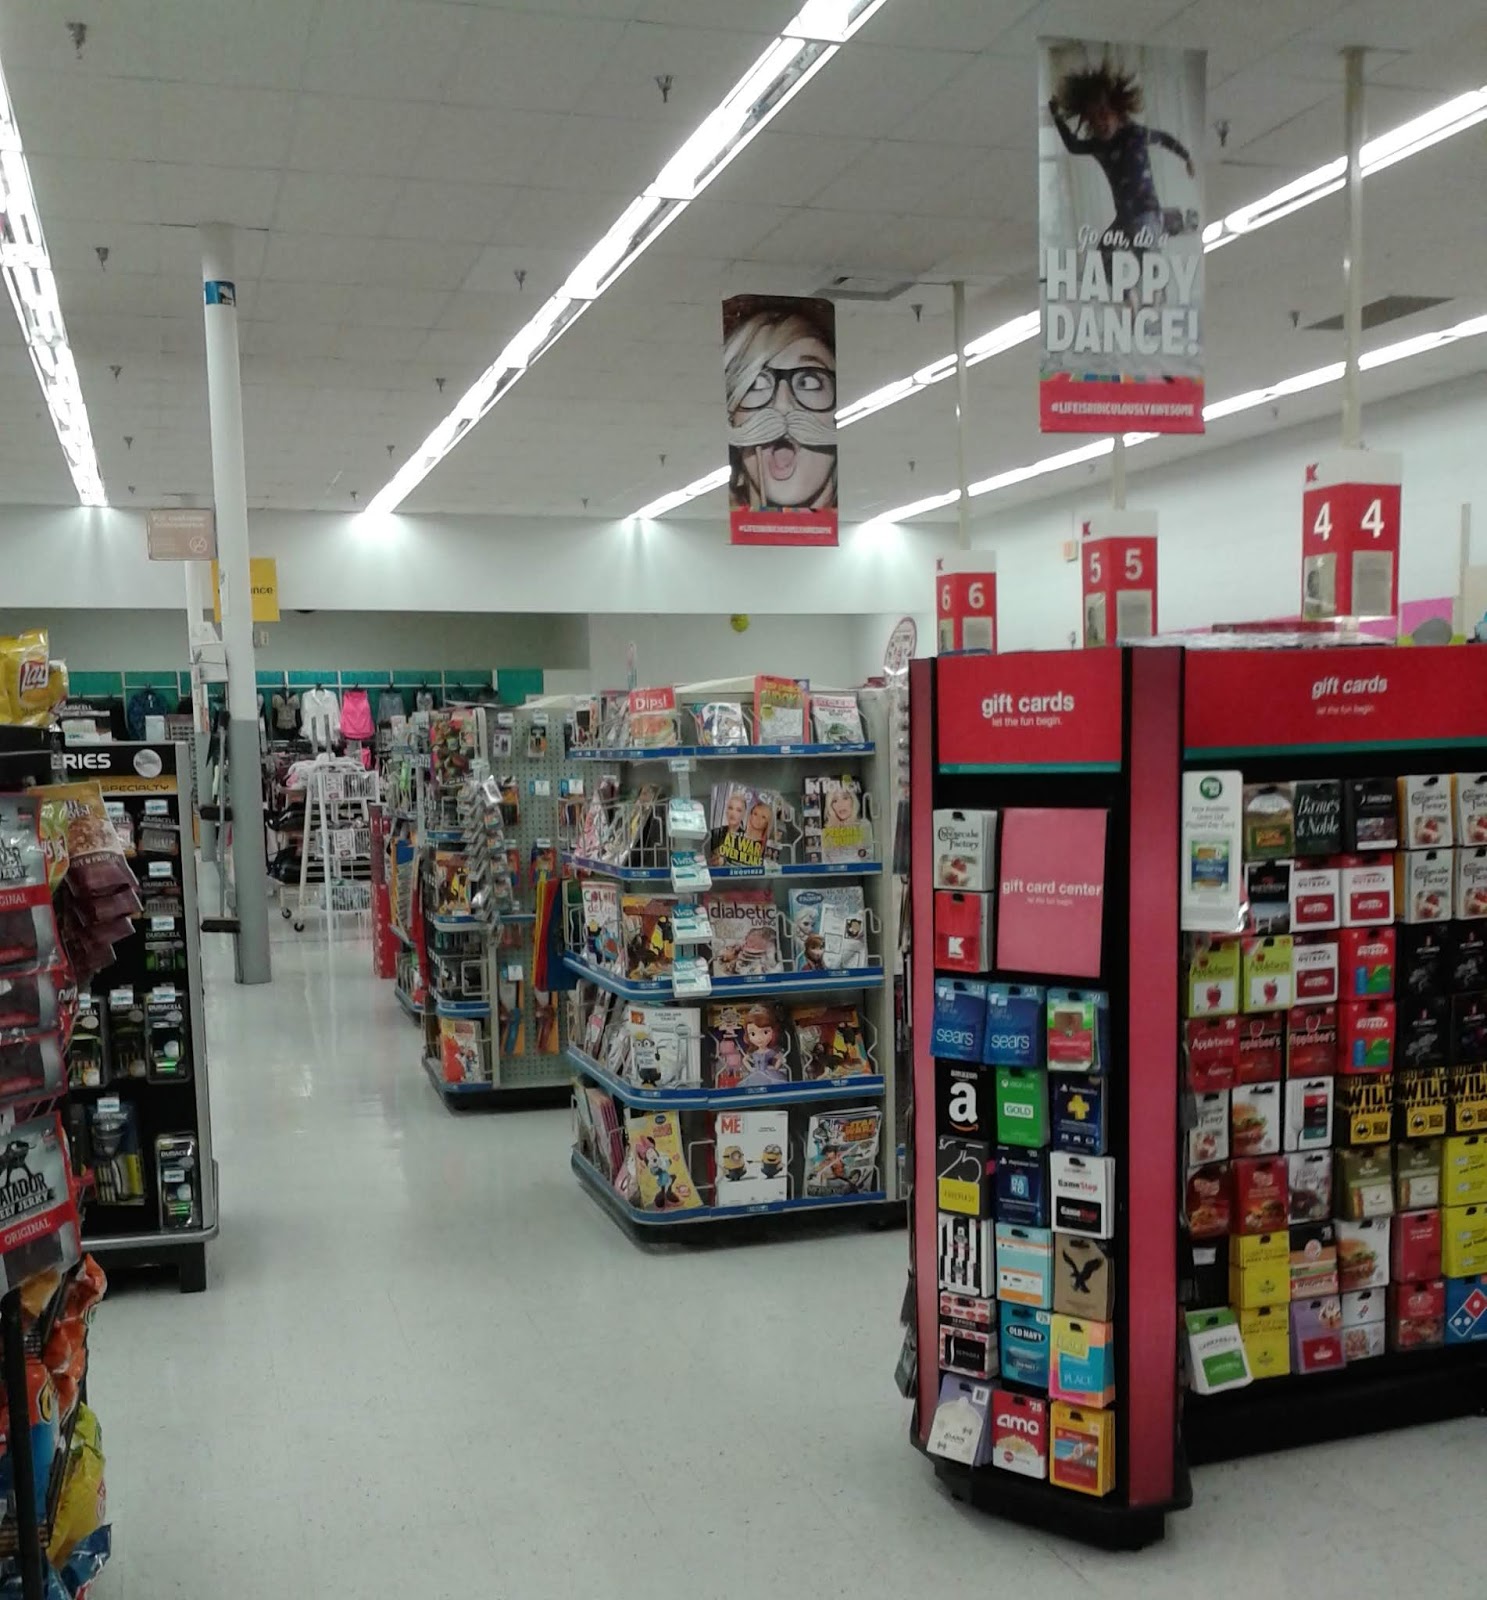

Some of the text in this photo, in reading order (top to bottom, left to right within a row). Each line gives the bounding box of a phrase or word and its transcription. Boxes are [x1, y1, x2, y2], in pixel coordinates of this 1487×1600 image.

[1077, 224, 1099, 249] Go
[1103, 228, 1130, 248] on,
[1133, 225, 1154, 248] do
[1046, 248, 1198, 305] HAPPY
[1046, 304, 1200, 356] DANCE!
[1313, 499, 1385, 541] 4 4
[1089, 548, 1143, 584] 5 5
[941, 582, 985, 611] 6 6
[1312, 675, 1388, 700] gift cards
[634, 697, 669, 710] Dips!
[981, 691, 1075, 719] gift cards
[1004, 717, 1018, 727] the
[51, 753, 111, 769] ERIES
[101, 784, 170, 793] SPECIALTY
[1298, 795, 1341, 816] Barnes
[143, 815, 176, 824] DURACELL
[1307, 815, 1340, 836] Noble
[724, 832, 762, 855] AT WAR
[720, 845, 738, 861] OVER
[1002, 879, 1102, 897] gift card center
[0, 893, 27, 905] GINAL
[710, 901, 776, 920] diabetic
[751, 918, 776, 927] LIVING
[146, 931, 181, 939] DURACELL
[936, 1027, 974, 1046] sears
[991, 1034, 1030, 1050] sears
[950, 1069, 978, 1079] amazon
[1402, 1077, 1449, 1101] WILD
[1451, 1072, 1487, 1097] WIL
[949, 1081, 978, 1124] a
[1006, 1104, 1033, 1117] GOLD
[721, 1119, 741, 1134] ME
[160, 1150, 193, 1158] DURACEL
[0, 1172, 47, 1206] ATADOR
[1058, 1178, 1099, 1193] GameStop
[17, 1192, 48, 1212] JERKY
[4, 1218, 51, 1246] ORIGINAL
[952, 1317, 976, 1328] SEPHORA
[1008, 1326, 1043, 1342] OLD NAVY
[956, 1349, 980, 1359] SEPHORA
[1064, 1374, 1093, 1386] PLACE
